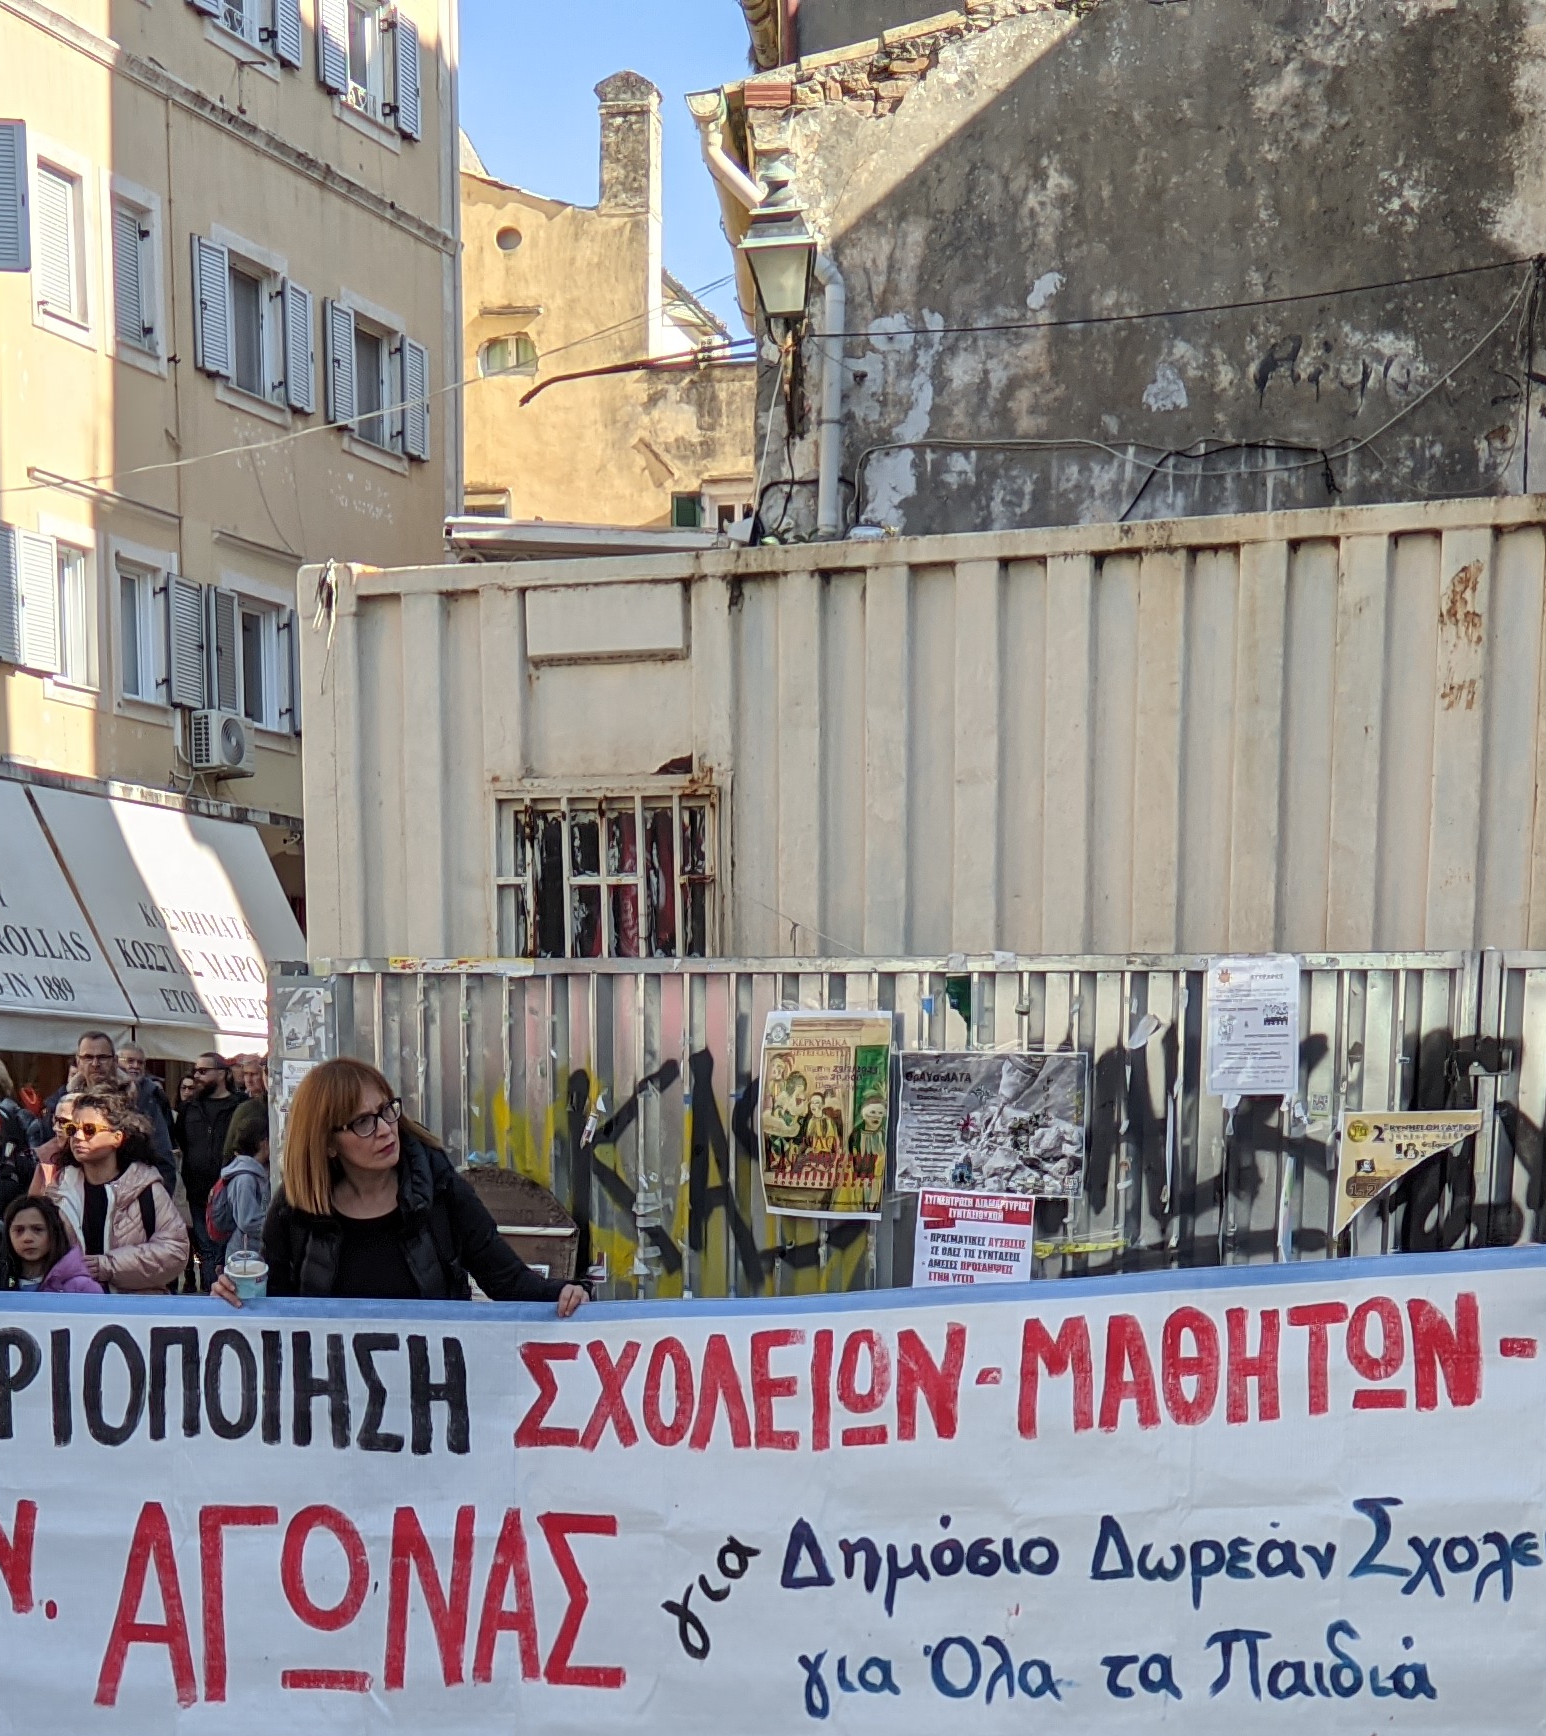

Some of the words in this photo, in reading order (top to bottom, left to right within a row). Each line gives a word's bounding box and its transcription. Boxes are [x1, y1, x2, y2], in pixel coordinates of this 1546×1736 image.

[4, 972, 34, 997] IN
[34, 975, 75, 1001] 1889
[200, 951, 267, 984] ΜΑΡΟ
[95, 1501, 627, 1708] ΑΓΩΝΑΣ
[661, 1534, 762, 1661] για
[780, 1513, 1060, 1617] Δημόσιο
[1090, 1513, 1337, 1610] Δωρεάν
[797, 1650, 902, 1721] για
[922, 1633, 1063, 1706] Όλα
[1099, 1650, 1182, 1700] τα
[1205, 1619, 1439, 1704] Παιδιά
